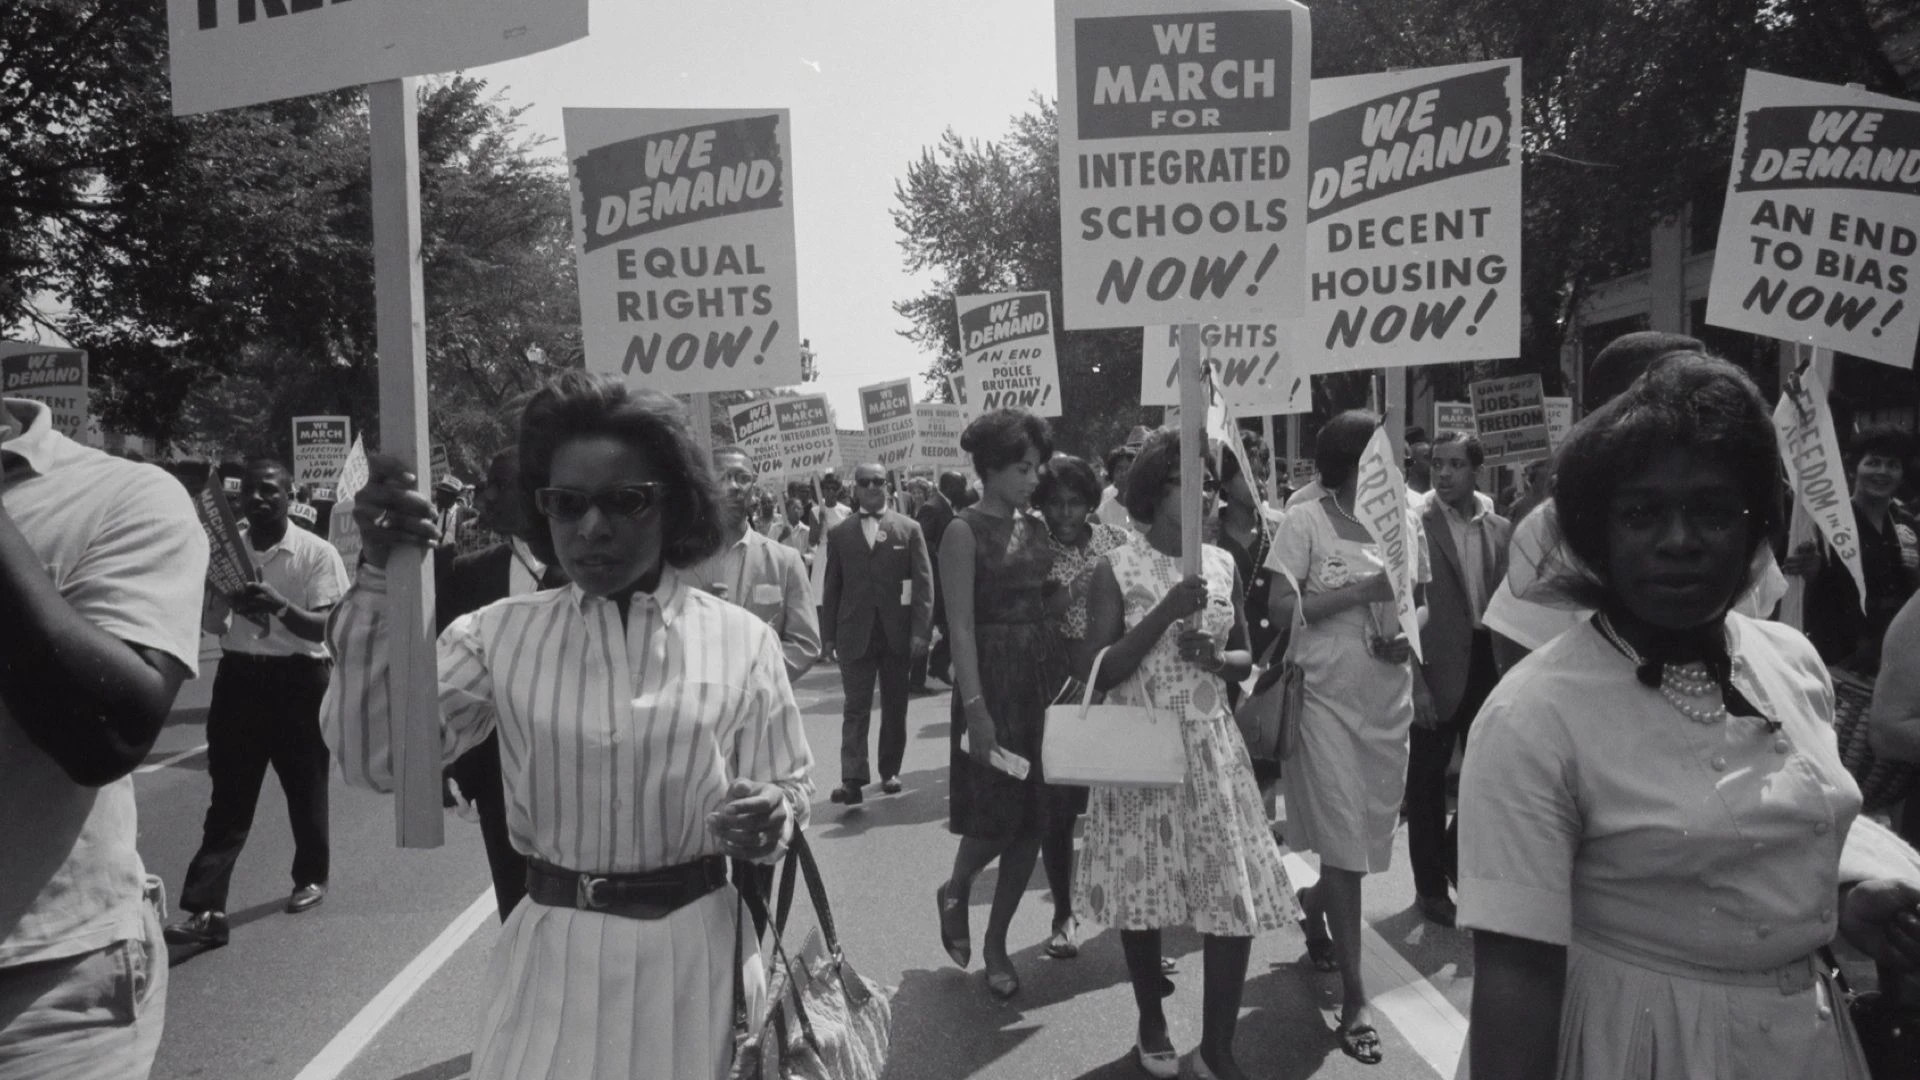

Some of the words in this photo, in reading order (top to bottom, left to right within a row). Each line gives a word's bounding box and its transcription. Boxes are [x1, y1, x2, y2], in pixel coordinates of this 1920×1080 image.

[1152, 22, 1217, 55] WE
[1093, 59, 1275, 105] MARCH
[1151, 108, 1221, 129] FOR
[1361, 89, 1440, 147] WE
[1808, 109, 1884, 144] WE
[644, 130, 716, 179] WE
[1078, 145, 1291, 189] INTEGRATED
[1308, 115, 1503, 210] DEMAND
[1750, 145, 1920, 183] DEMAND
[595, 159, 775, 236] DEMAND
[1080, 198, 1288, 241] SCHOOLS
[1328, 206, 1491, 253] DECENT
[1750, 199, 1815, 236] AN
[1829, 212, 1918, 257] END
[616, 244, 765, 280] EQUAL
[1096, 242, 1280, 305] NOW!
[1751, 235, 1803, 271] TO
[1815, 248, 1908, 294] BIAS
[1311, 254, 1507, 301] HOUSING
[617, 284, 772, 322] RIGHTS
[989, 300, 1020, 323] WE
[1742, 276, 1904, 337] NOW!
[969, 312, 1045, 350] DEMAND
[1325, 287, 1497, 350] NOW!
[621, 319, 779, 375] NOW!
[1168, 324, 1277, 348] RGHTS
[28, 354, 57, 369] WE
[977, 350, 1003, 363] AN
[1009, 348, 1042, 360] END
[8, 367, 80, 388] DEMAND
[982, 376, 1041, 391] BRUTALITY
[992, 365, 1033, 378] POLICE
[983, 384, 1051, 410] NOW!
[1477, 383, 1504, 395] UAW
[750, 404, 768, 420] WE
[781, 408, 823, 423] MARCH
[792, 402, 807, 410] WE
[868, 396, 907, 415] MARCH
[1477, 393, 1520, 413] JOBS
[781, 426, 830, 441] INTEGRATED
[868, 423, 890, 436] FIRST
[891, 418, 913, 430] CLASS
[1479, 410, 1544, 432] FREEDOM
[300, 430, 343, 439] MARCH
[764, 435, 776, 443] EN
[784, 439, 833, 454] SCHOOLS
[868, 429, 916, 449] CITIZENSHIP
[791, 449, 833, 468] NOW!
[879, 442, 914, 463] NOW!
[921, 446, 959, 457] REEDOM
[1781, 388, 1840, 512] FREEDOM
[1826, 513, 1840, 528] IN
[200, 487, 227, 534] MARCH
[1358, 453, 1405, 573] FREEDOM
